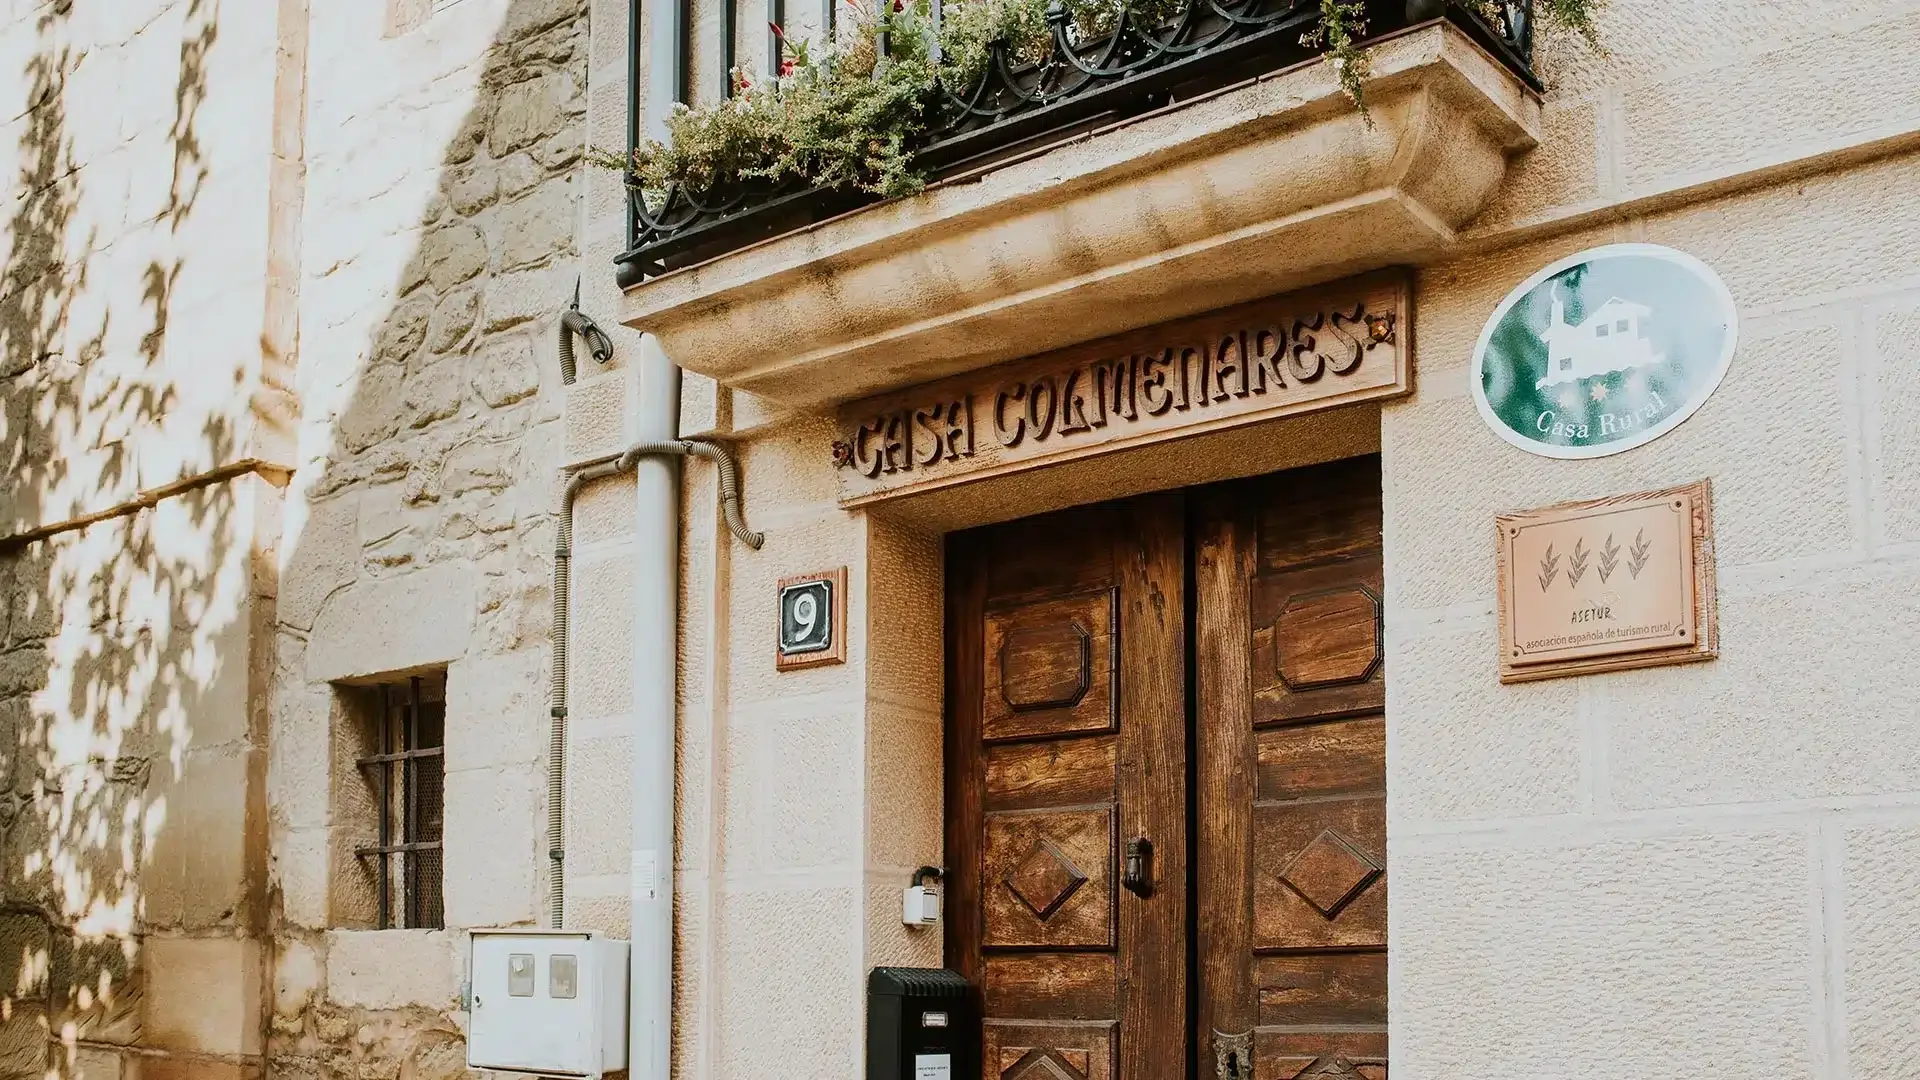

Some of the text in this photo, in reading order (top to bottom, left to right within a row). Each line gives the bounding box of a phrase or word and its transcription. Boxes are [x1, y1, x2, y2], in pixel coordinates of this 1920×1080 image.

[853, 302, 1366, 479] CASA COLMENARES
[1536, 391, 1667, 439] Casa Rural
[793, 592, 817, 642] 9
[1526, 620, 1671, 649] asociación española de turismo rural
[1571, 607, 1611, 624] ASETUR
